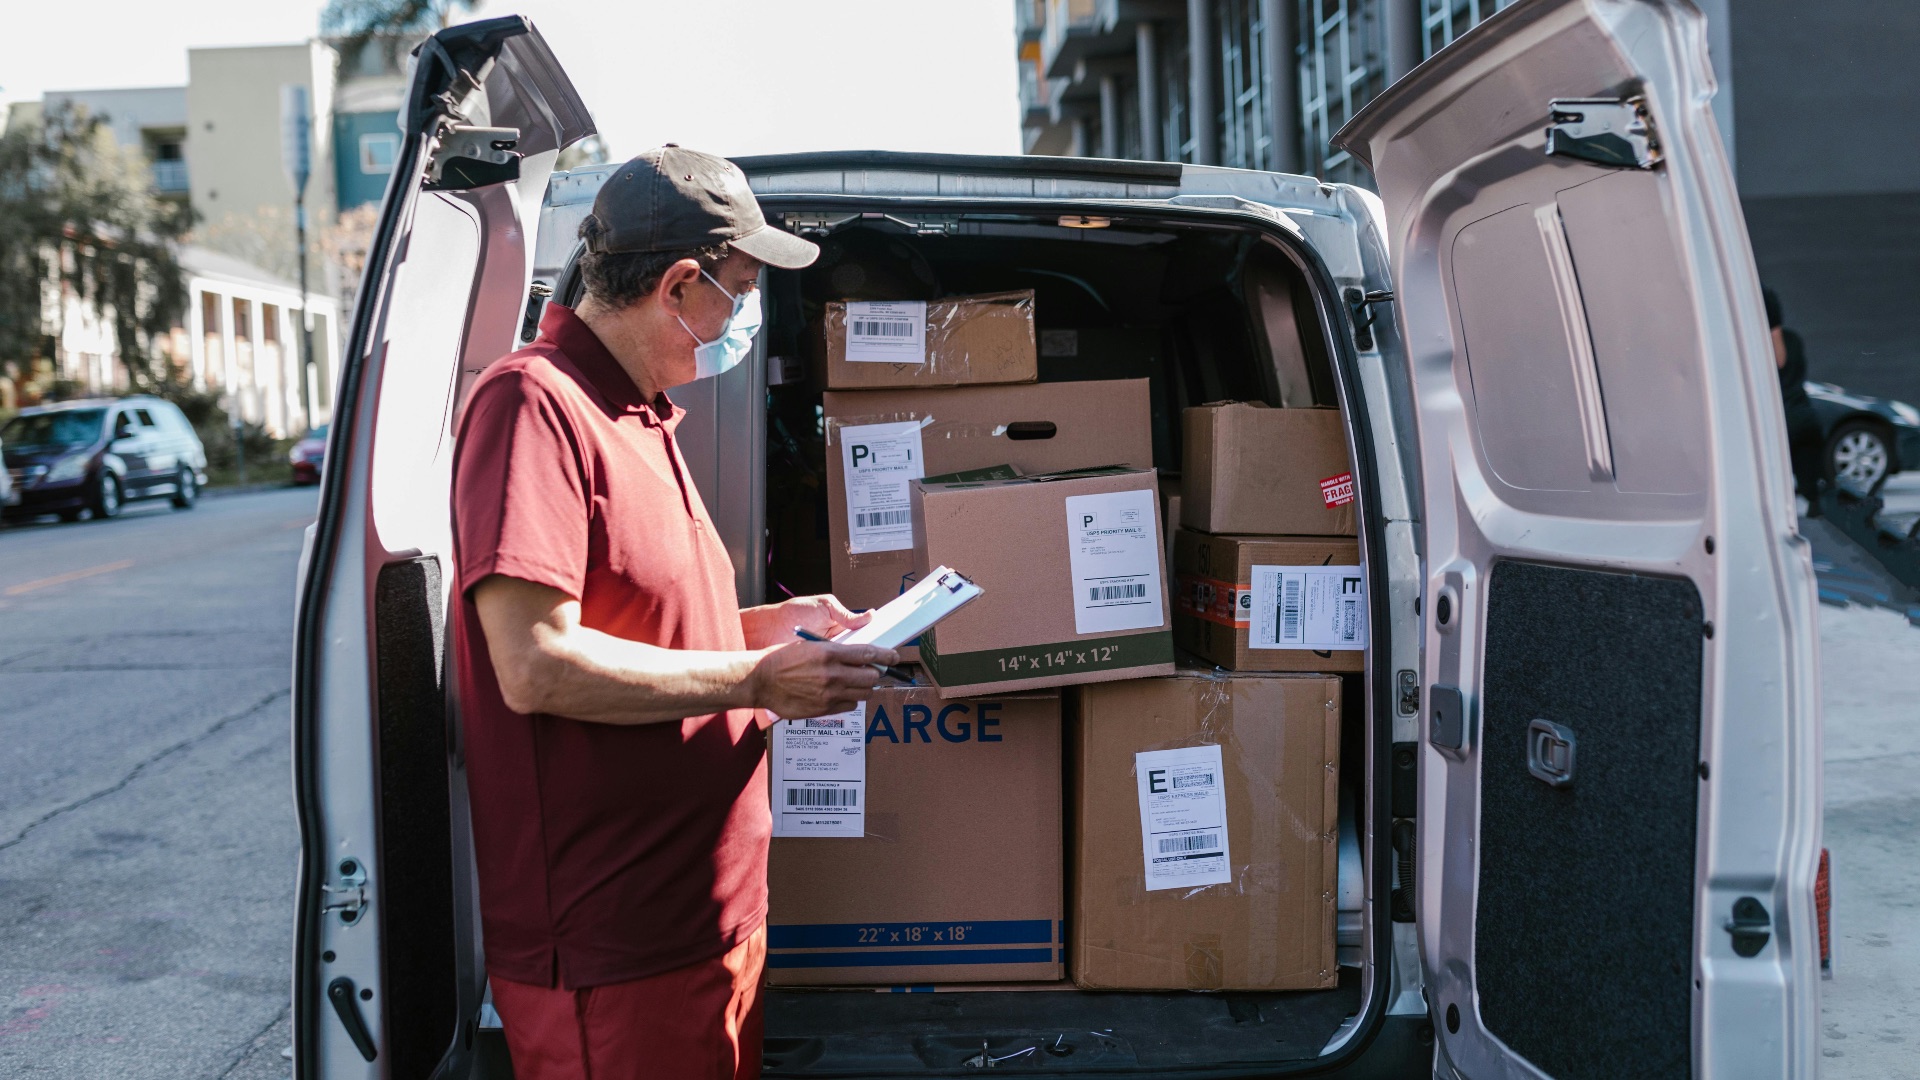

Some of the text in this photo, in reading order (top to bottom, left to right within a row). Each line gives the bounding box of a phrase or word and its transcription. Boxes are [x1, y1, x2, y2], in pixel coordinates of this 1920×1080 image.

[851, 445, 869, 467] P
[1084, 515, 1093, 528] P
[999, 646, 1119, 672] 14" x 14" x 12"
[865, 703, 1003, 744] ARGE
[1149, 770, 1167, 794] E
[858, 926, 973, 943] 22" x 18" x 18"
